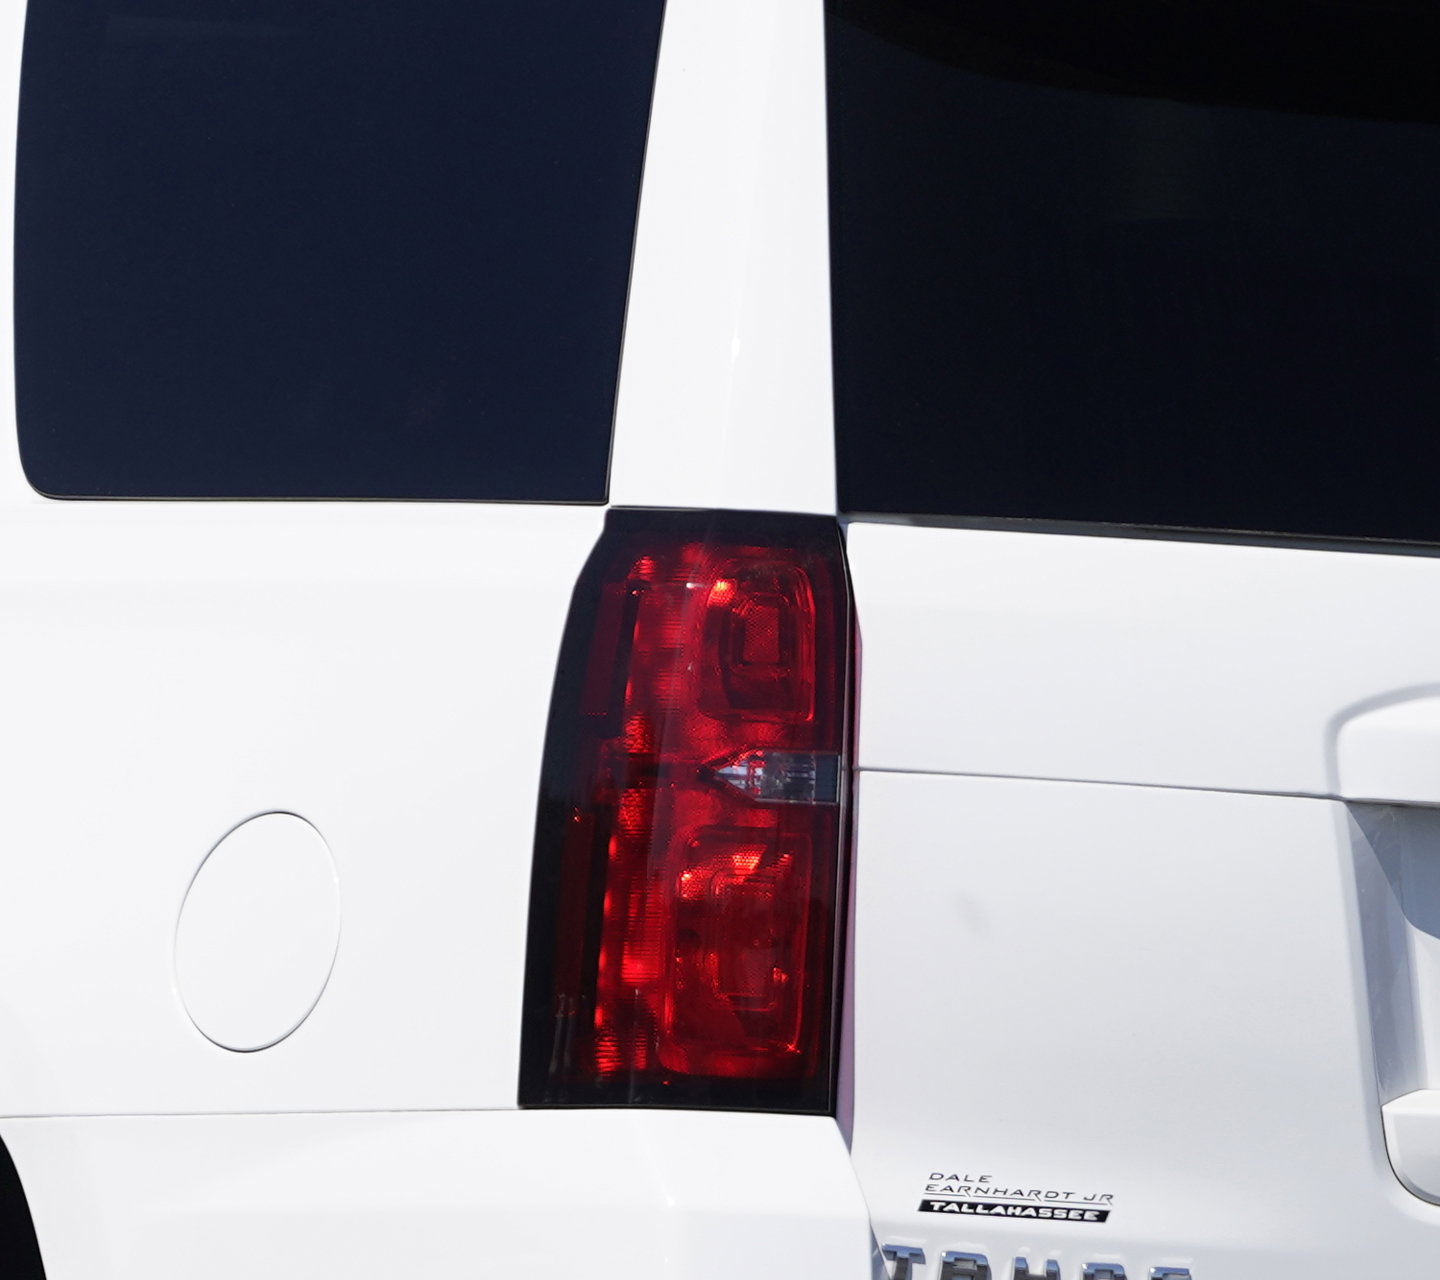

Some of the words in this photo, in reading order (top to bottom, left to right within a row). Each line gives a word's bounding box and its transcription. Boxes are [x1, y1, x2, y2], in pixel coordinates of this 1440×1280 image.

[928, 1172, 993, 1183] DALE
[925, 1184, 1076, 1201] EARNHARDT
[1084, 1192, 1115, 1205] JR
[929, 1201, 1100, 1221] TALLAHASSEE
